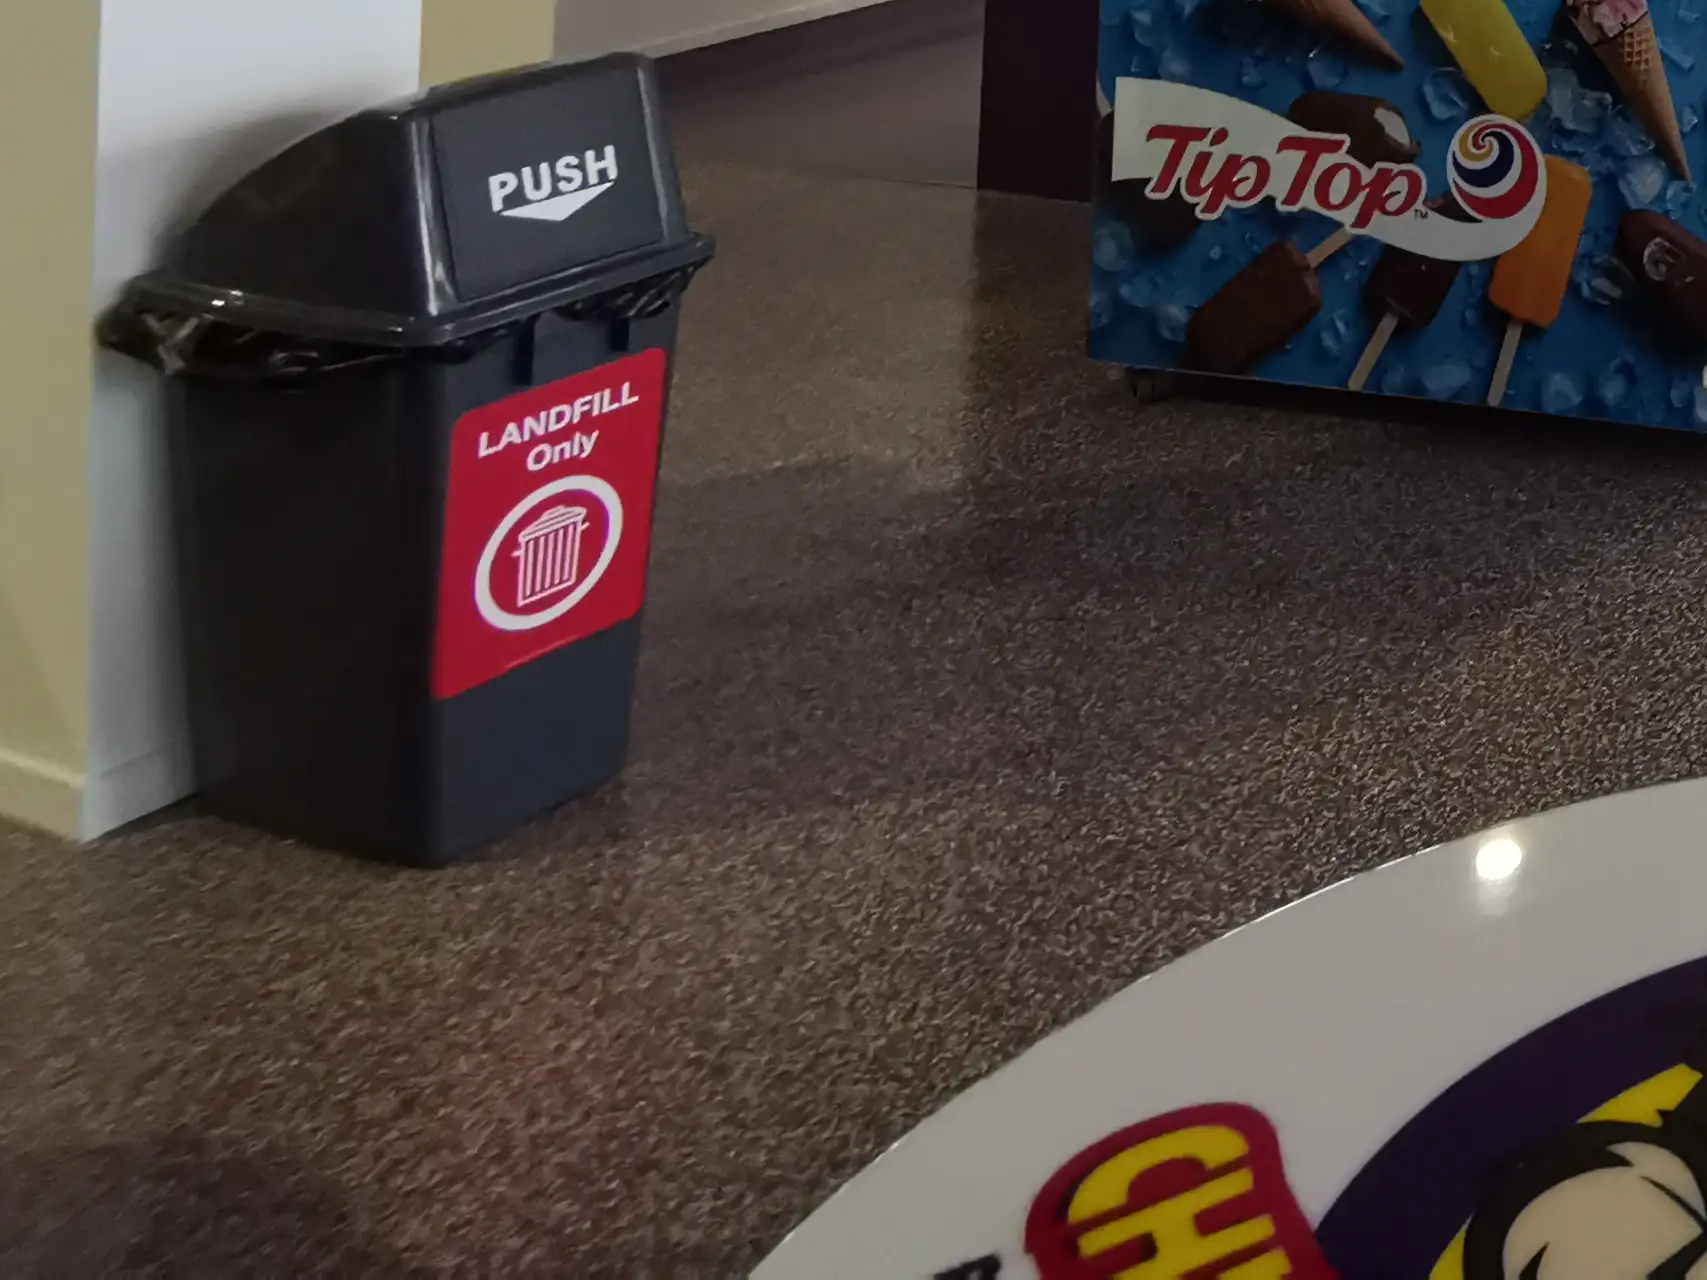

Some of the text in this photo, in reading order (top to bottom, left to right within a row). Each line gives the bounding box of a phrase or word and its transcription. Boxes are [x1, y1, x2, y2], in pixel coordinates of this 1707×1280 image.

[488, 144, 619, 213] PUSH
[478, 381, 639, 458] LANDFILL
[526, 428, 600, 473] Only
